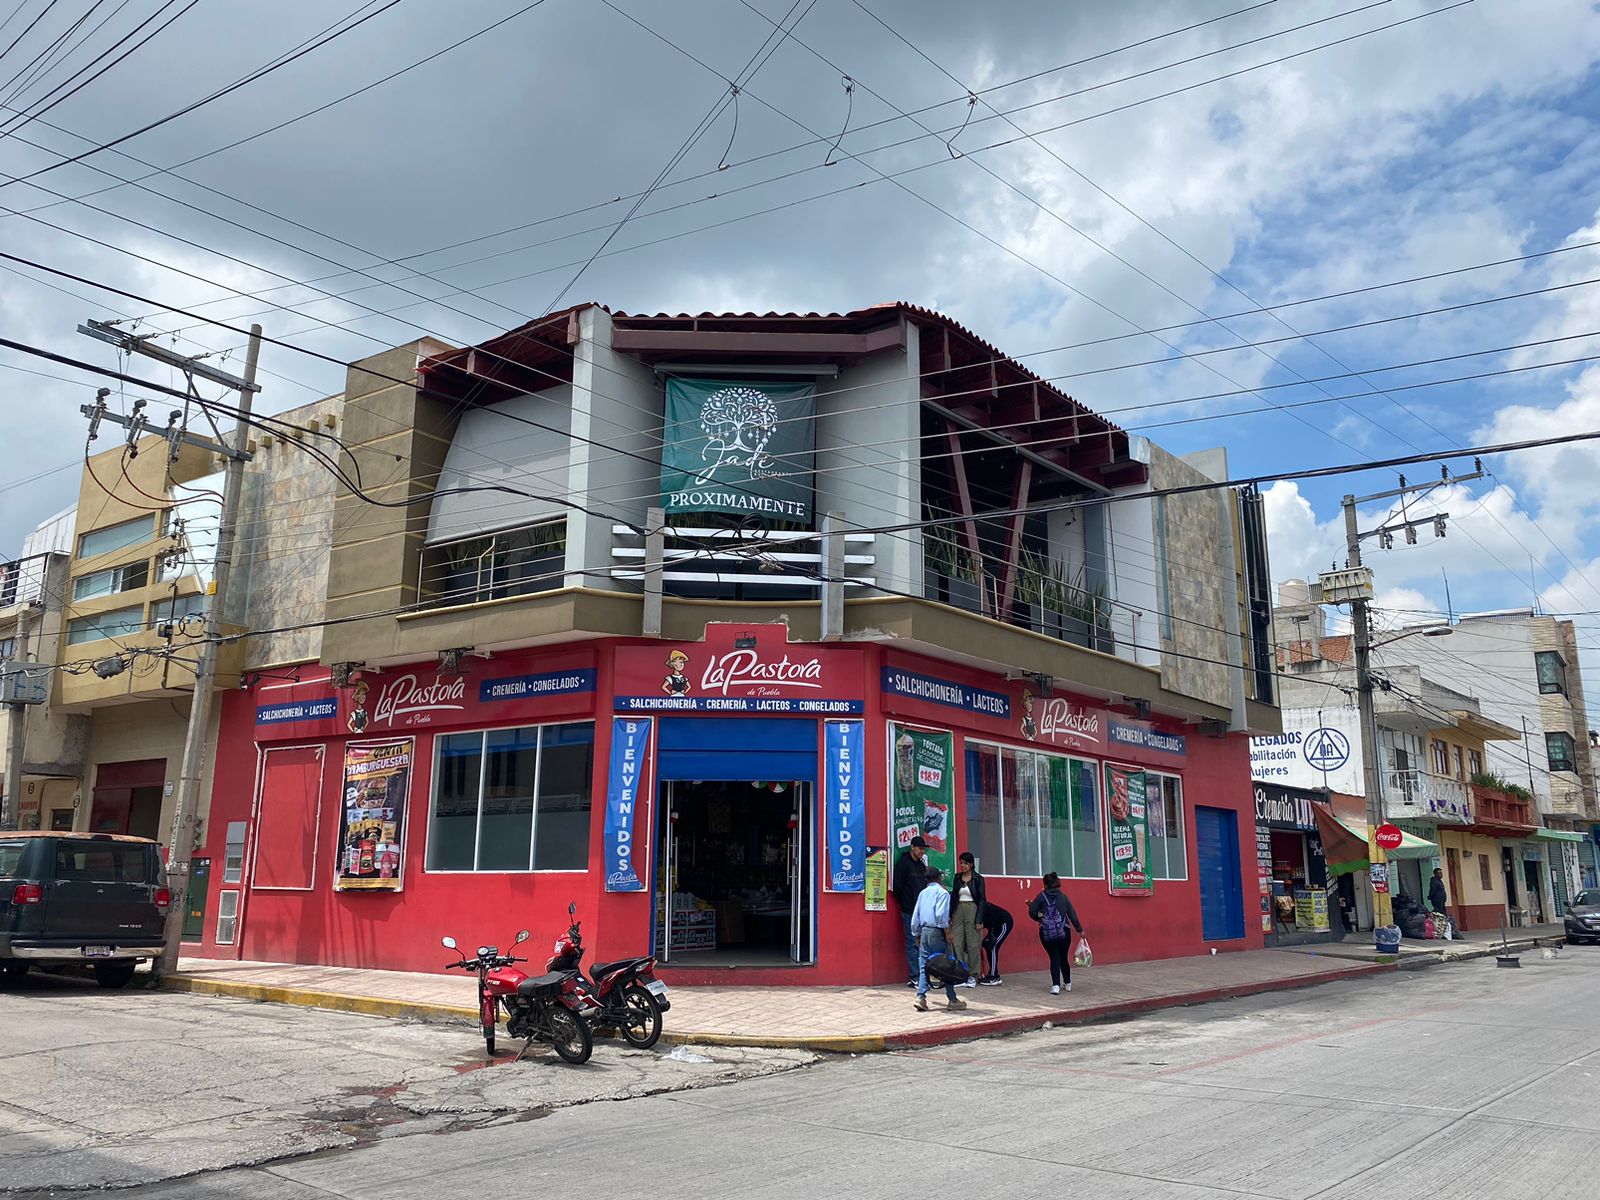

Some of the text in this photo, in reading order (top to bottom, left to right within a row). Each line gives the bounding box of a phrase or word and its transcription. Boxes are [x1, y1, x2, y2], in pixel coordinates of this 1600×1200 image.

[670, 492, 805, 516] PROXIMAMENTE
[492, 676, 580, 697] CREMERÍA CONGELADOS
[719, 649, 822, 696] Pastora
[262, 704, 333, 721] SALCHICHONERÍA LACTEOS
[388, 674, 465, 727] Pastora
[629, 698, 850, 712] SALCHICHONERÍA CREMERÍA LACTEOS CONGELADOS
[895, 674, 1004, 714] SALCHICHONERÍA LACTEOS
[1048, 698, 1099, 743] Pastora
[1116, 726, 1180, 752] CREMERÍA CONGELADOS
[616, 722, 638, 872] BIENVENIDOS
[838, 723, 853, 872] BIENVENIDOS
